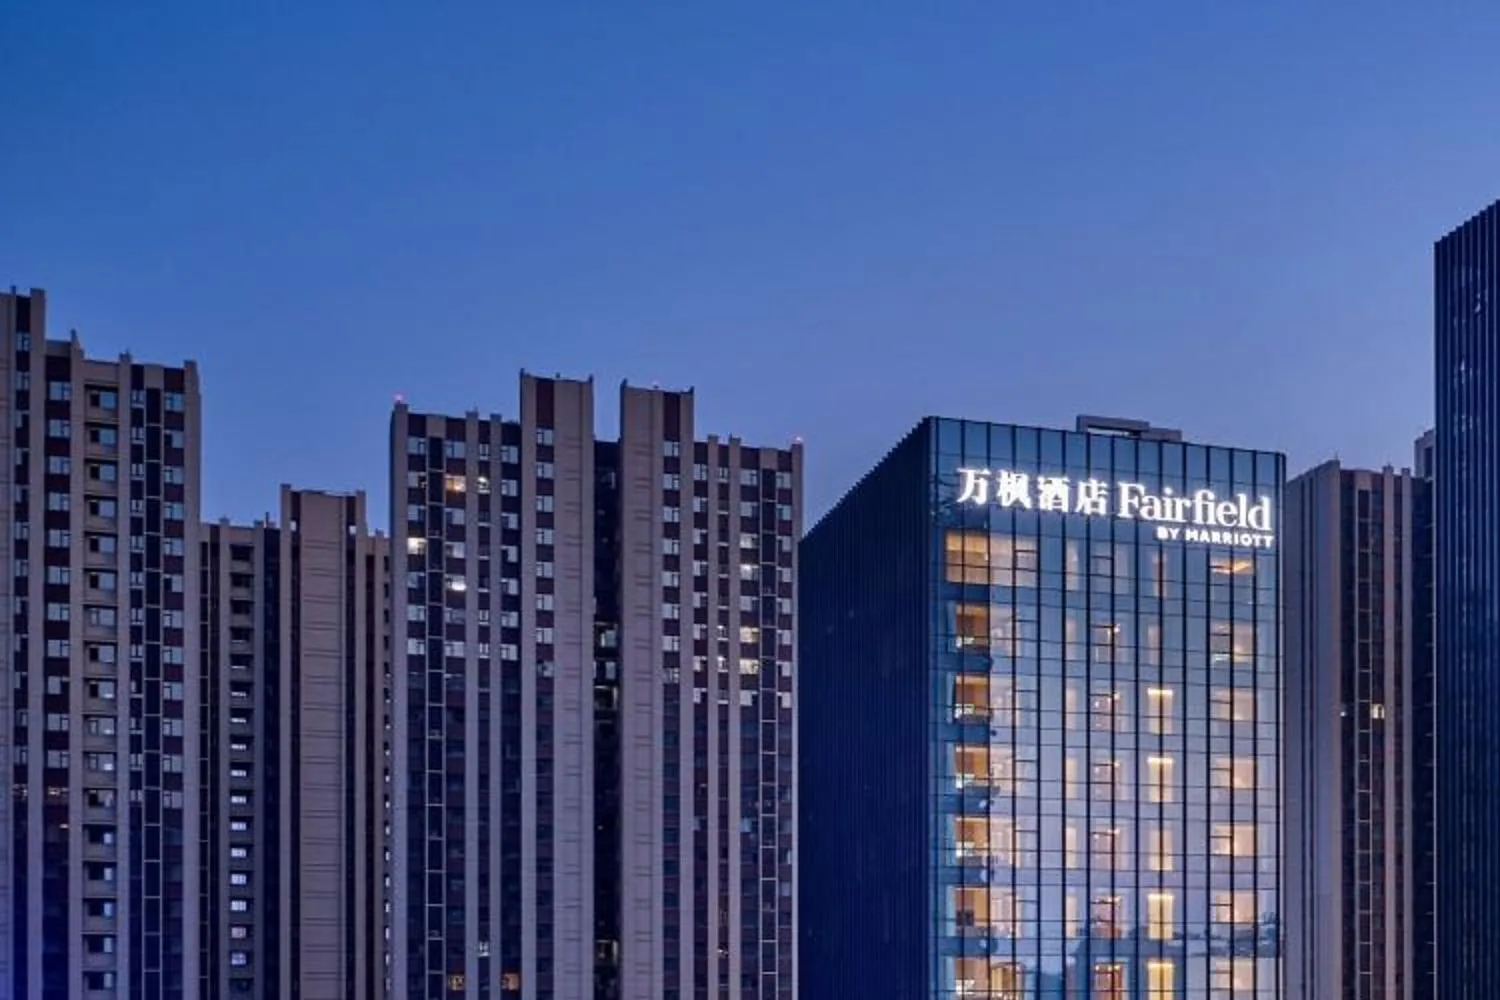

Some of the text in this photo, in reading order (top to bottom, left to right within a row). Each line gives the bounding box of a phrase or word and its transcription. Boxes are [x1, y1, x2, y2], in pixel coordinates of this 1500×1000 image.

[956, 467, 1272, 531] 万枫酒店 Fairfield
[1156, 525, 1274, 548] BY MARRIOTT
